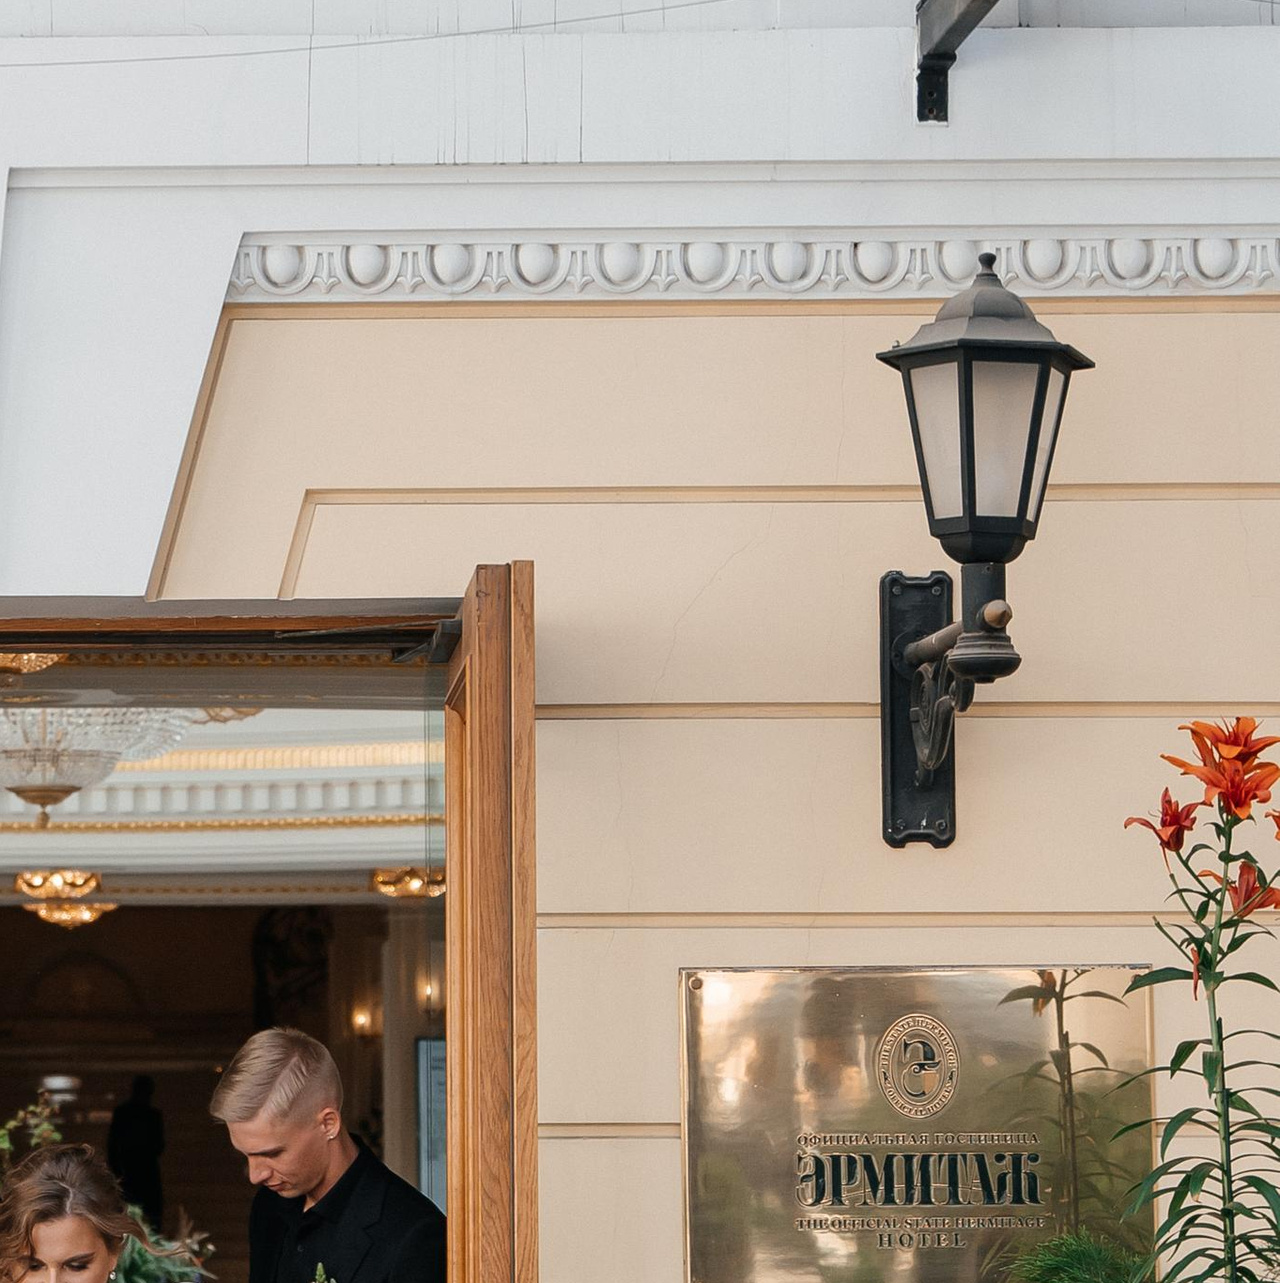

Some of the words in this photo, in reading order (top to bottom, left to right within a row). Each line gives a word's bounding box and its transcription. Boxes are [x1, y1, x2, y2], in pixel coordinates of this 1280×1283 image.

[926, 1085, 952, 1113] HOTEL
[796, 1132, 930, 1147] ОФИЦИАЛЬНАЯ
[933, 1133, 1041, 1146] ГОСТИНИЦА
[795, 1150, 1046, 1207] ЭРМИТАЖ
[795, 1217, 829, 1230] THE
[830, 1217, 900, 1230] OFFICIAL
[904, 1217, 951, 1229] STATE
[955, 1217, 1046, 1229] HERMITAGE
[877, 1232, 967, 1249] HOTEL
